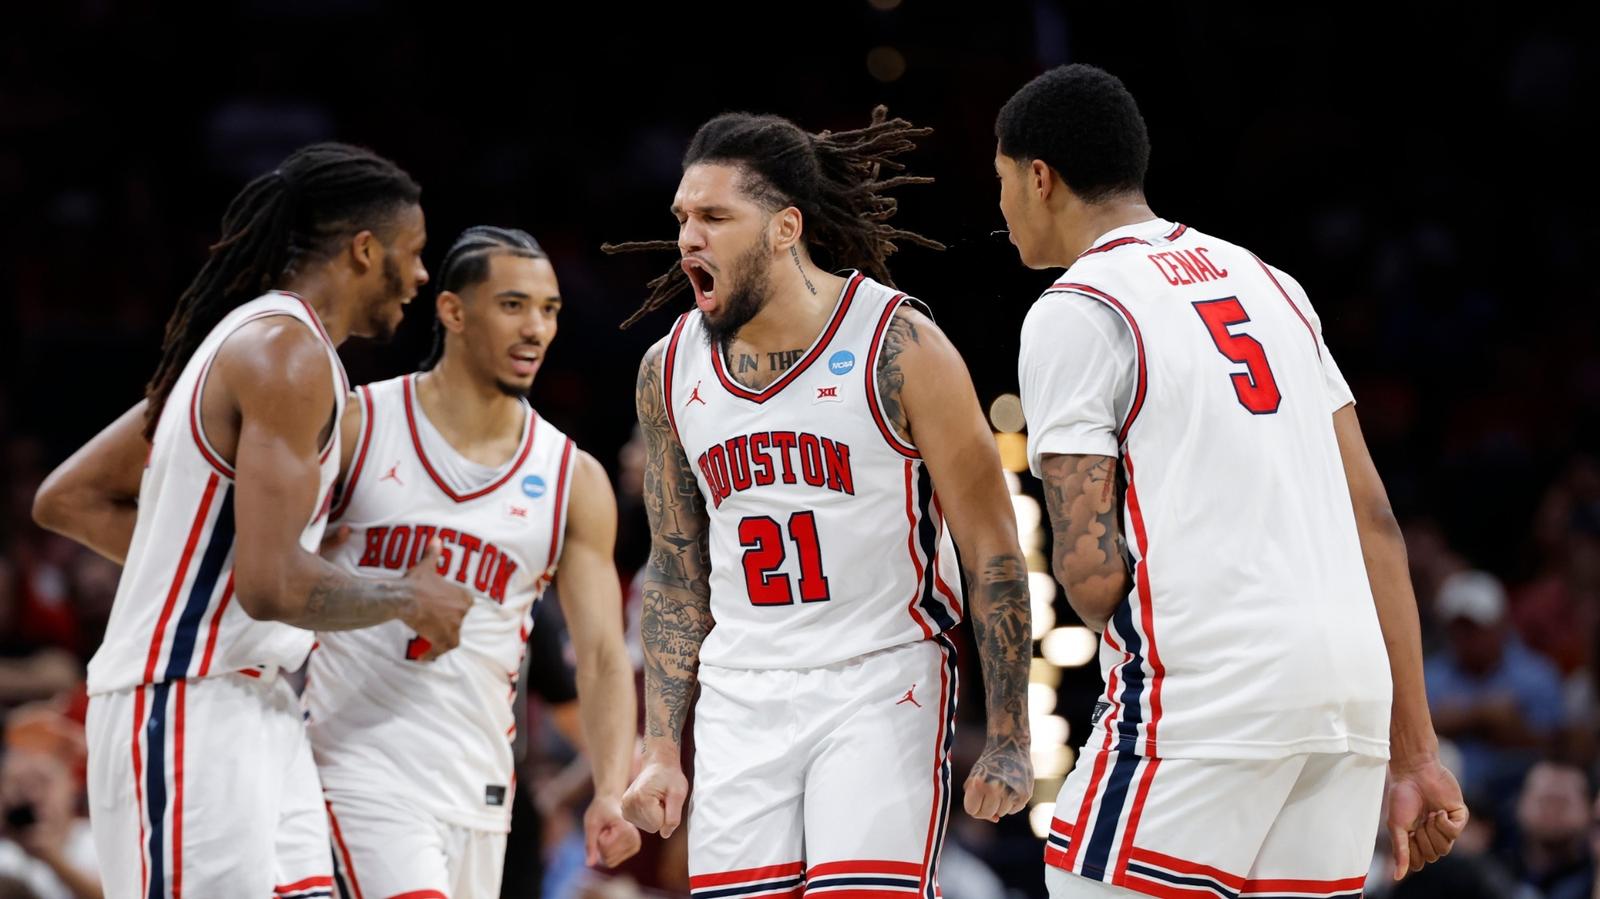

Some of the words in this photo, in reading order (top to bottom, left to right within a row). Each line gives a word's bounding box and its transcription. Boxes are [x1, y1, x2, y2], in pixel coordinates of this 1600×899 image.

[1147, 247, 1228, 286] CENAC
[1191, 296, 1282, 415] 5
[698, 431, 855, 509] HOUSTON
[738, 510, 831, 606] 21
